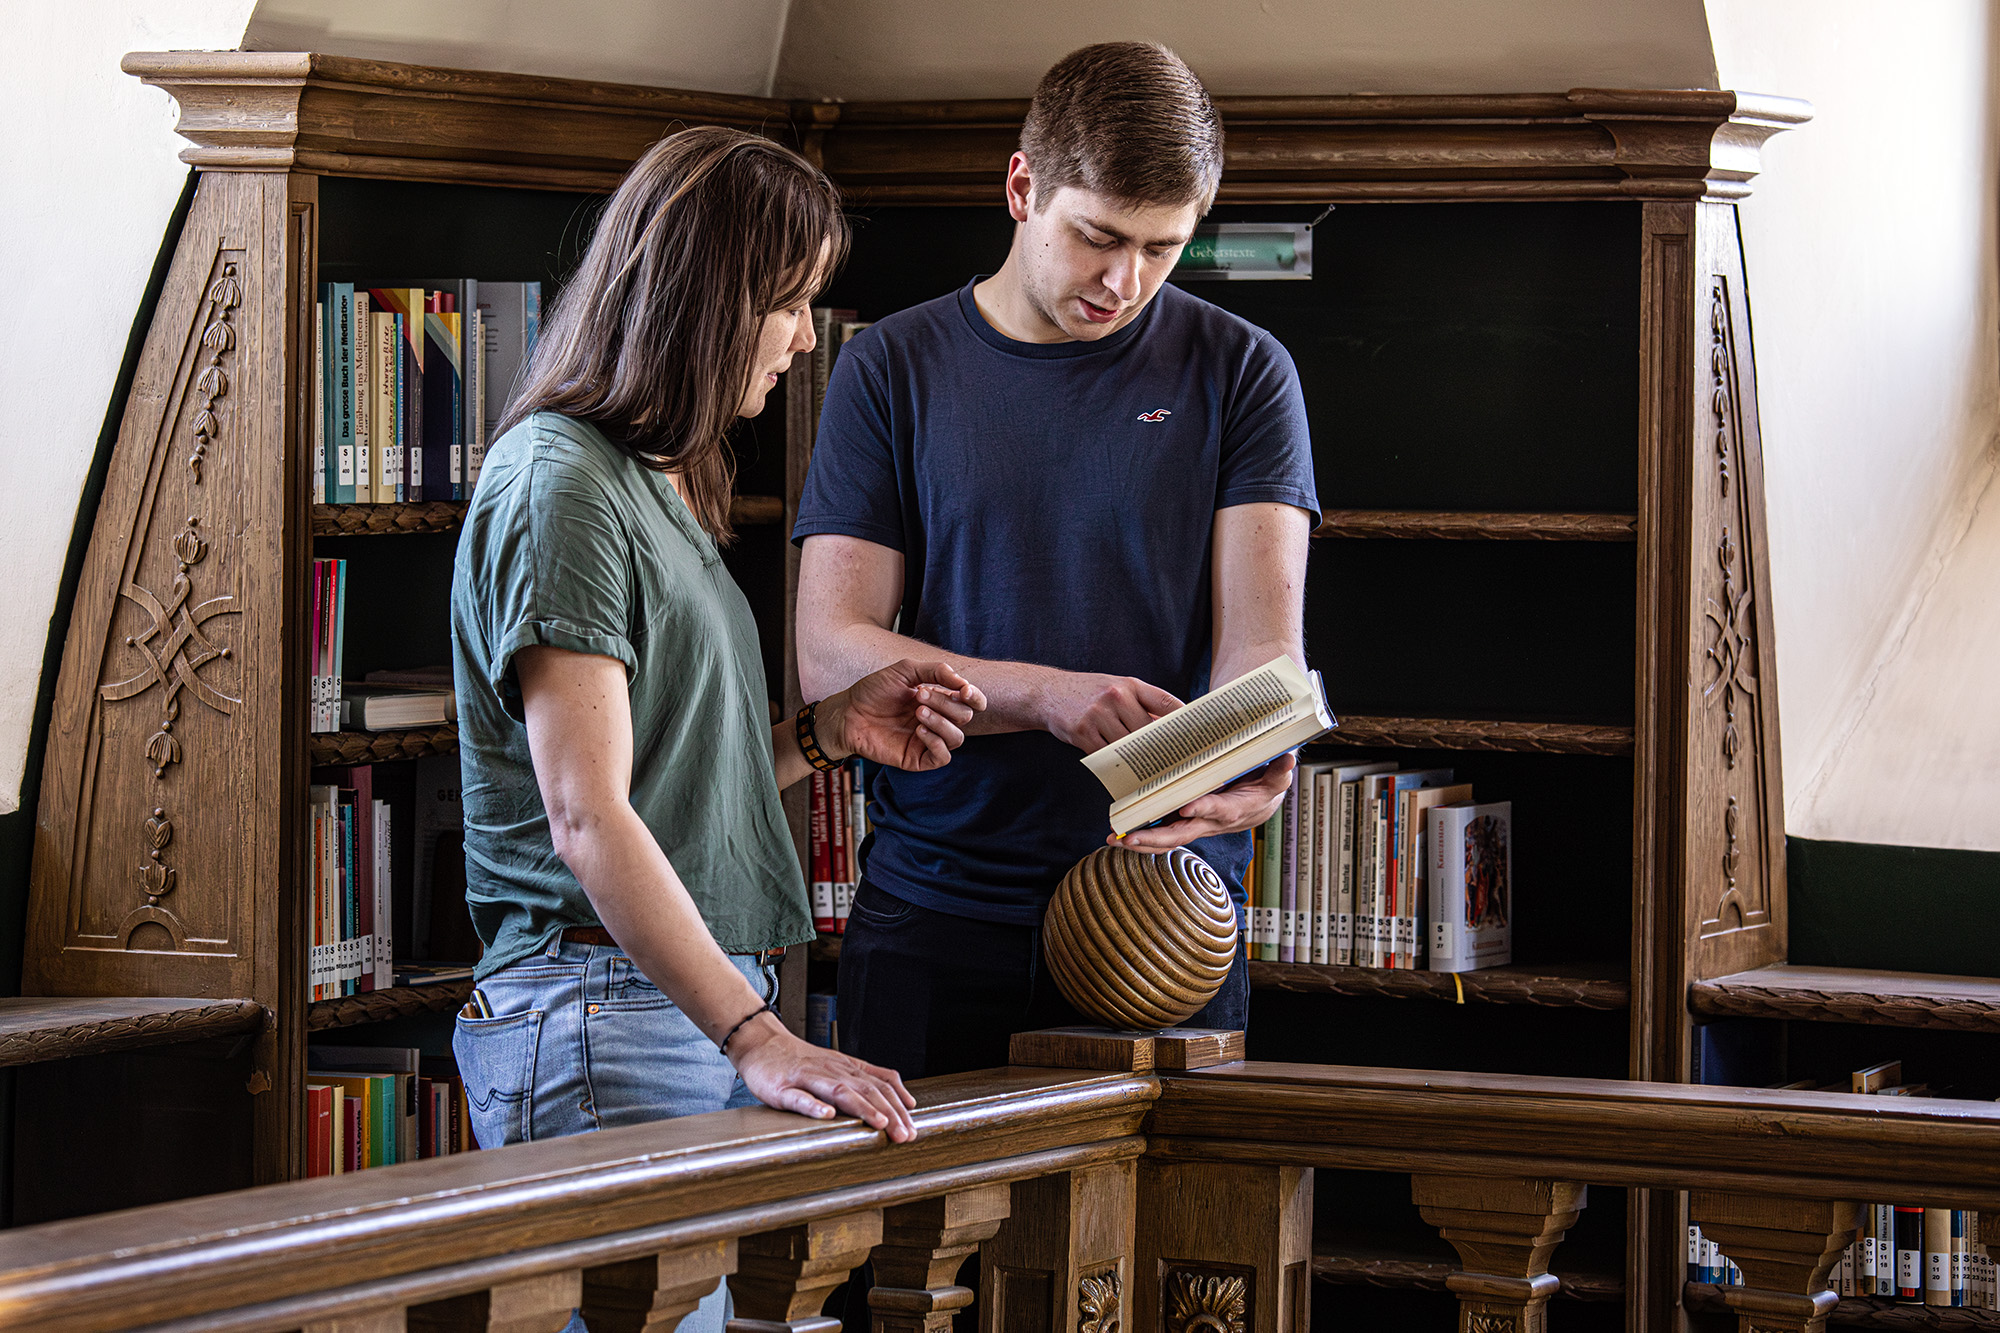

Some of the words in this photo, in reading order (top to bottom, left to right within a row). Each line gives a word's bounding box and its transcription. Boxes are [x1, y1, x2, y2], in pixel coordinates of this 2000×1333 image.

[340, 295, 348, 345] Meditation
[356, 301, 363, 316] am
[355, 318, 363, 370] Meditieren
[341, 366, 349, 387] Buch
[355, 373, 363, 387] ins
[342, 389, 350, 419] grosse
[355, 389, 364, 435] Einübung
